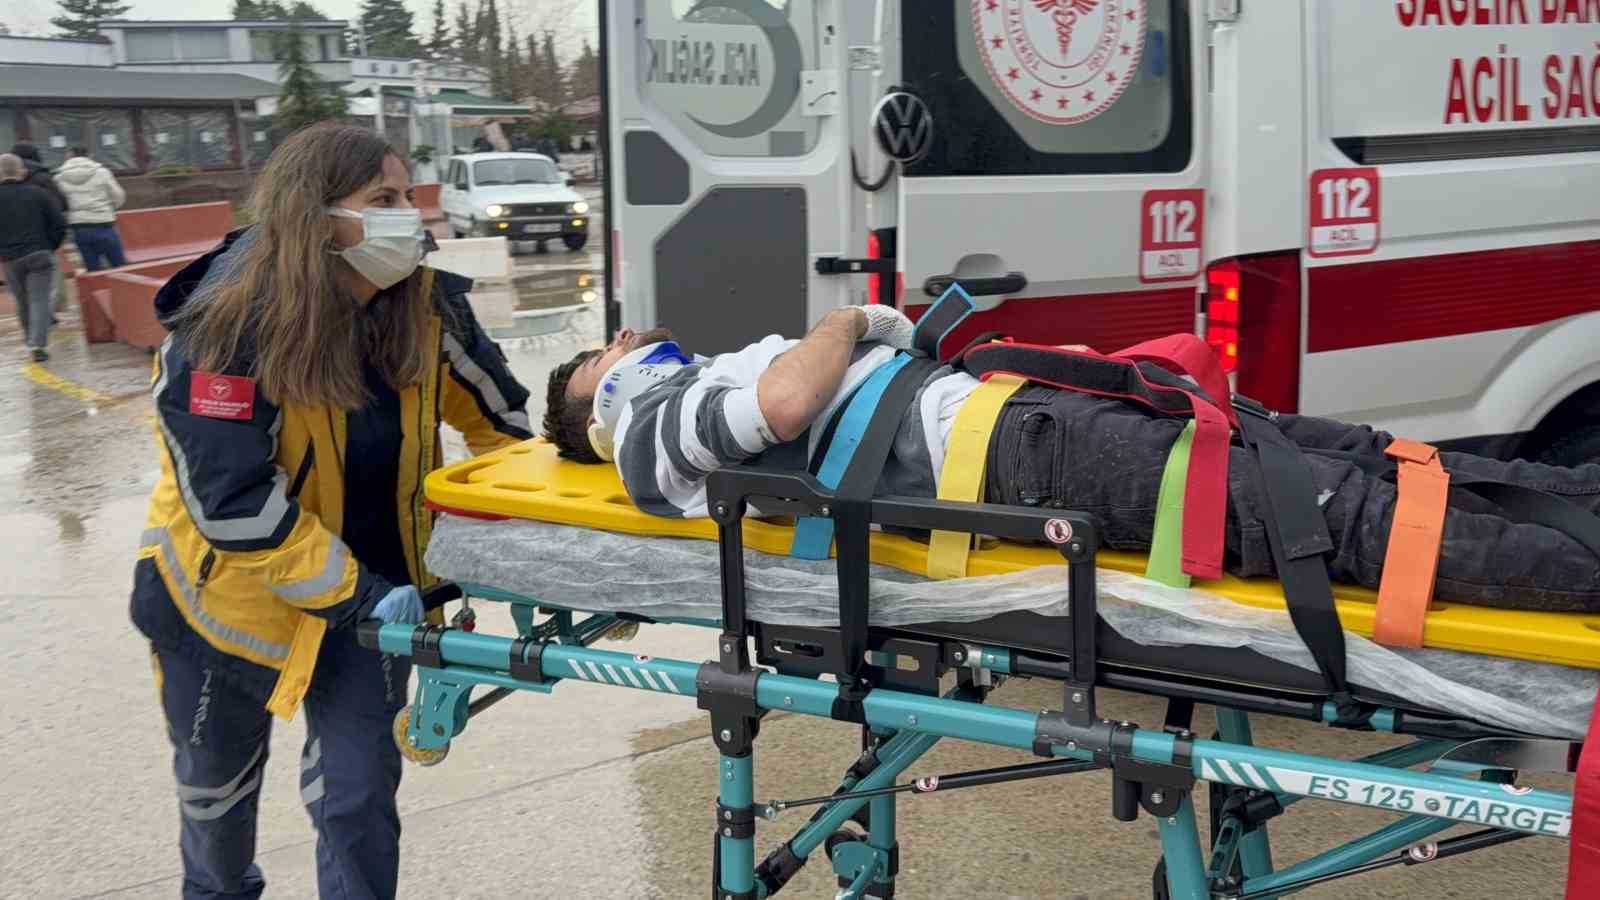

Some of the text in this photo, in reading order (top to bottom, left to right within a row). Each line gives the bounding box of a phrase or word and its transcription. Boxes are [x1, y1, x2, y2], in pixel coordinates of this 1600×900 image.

[1443, 43, 1530, 124] ACİL
[1150, 200, 1196, 243] 112
[1318, 176, 1371, 220] 112
[1308, 775, 1572, 834] ES 125 TARGE
